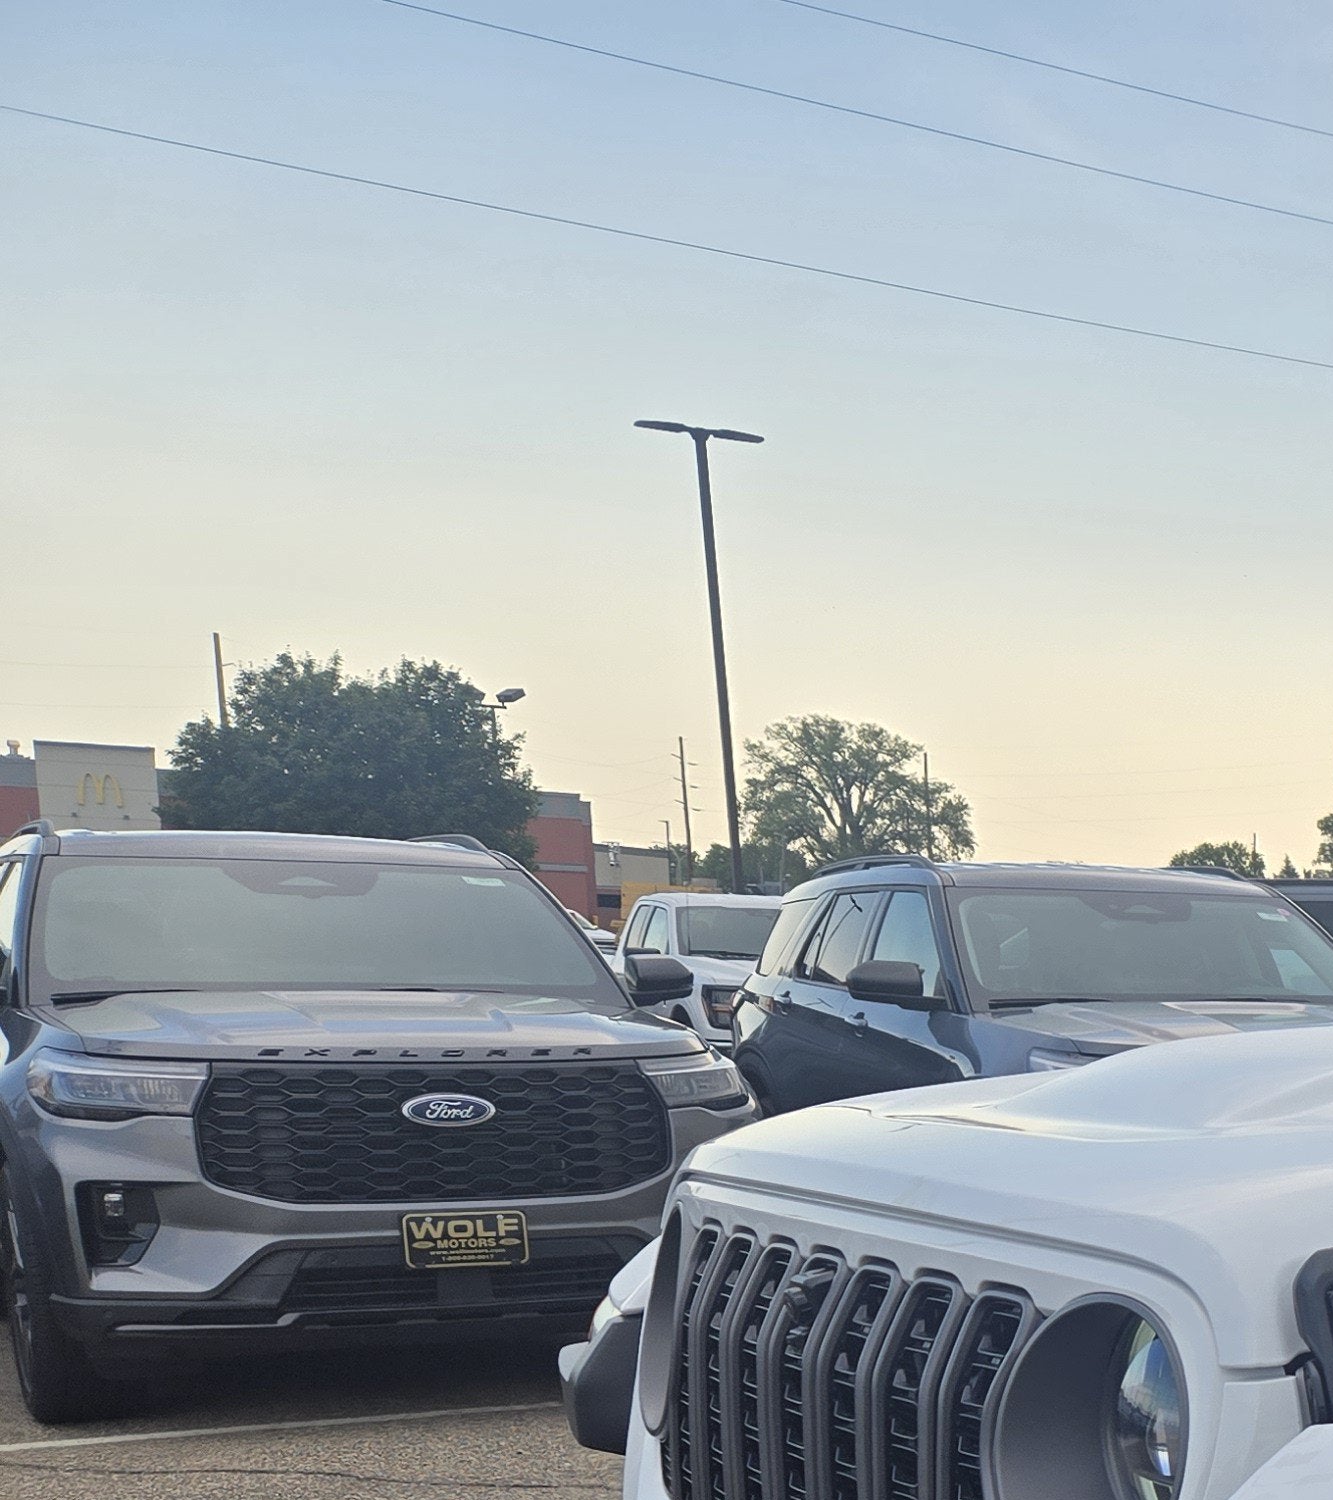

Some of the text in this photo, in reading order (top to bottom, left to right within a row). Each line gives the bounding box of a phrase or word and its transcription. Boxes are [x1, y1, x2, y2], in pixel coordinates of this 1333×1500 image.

[257, 1047, 594, 1058] EXPLORER
[425, 1100, 475, 1121] Ford
[409, 1217, 519, 1239] WOLF
[436, 1237, 498, 1249] MOTORS
